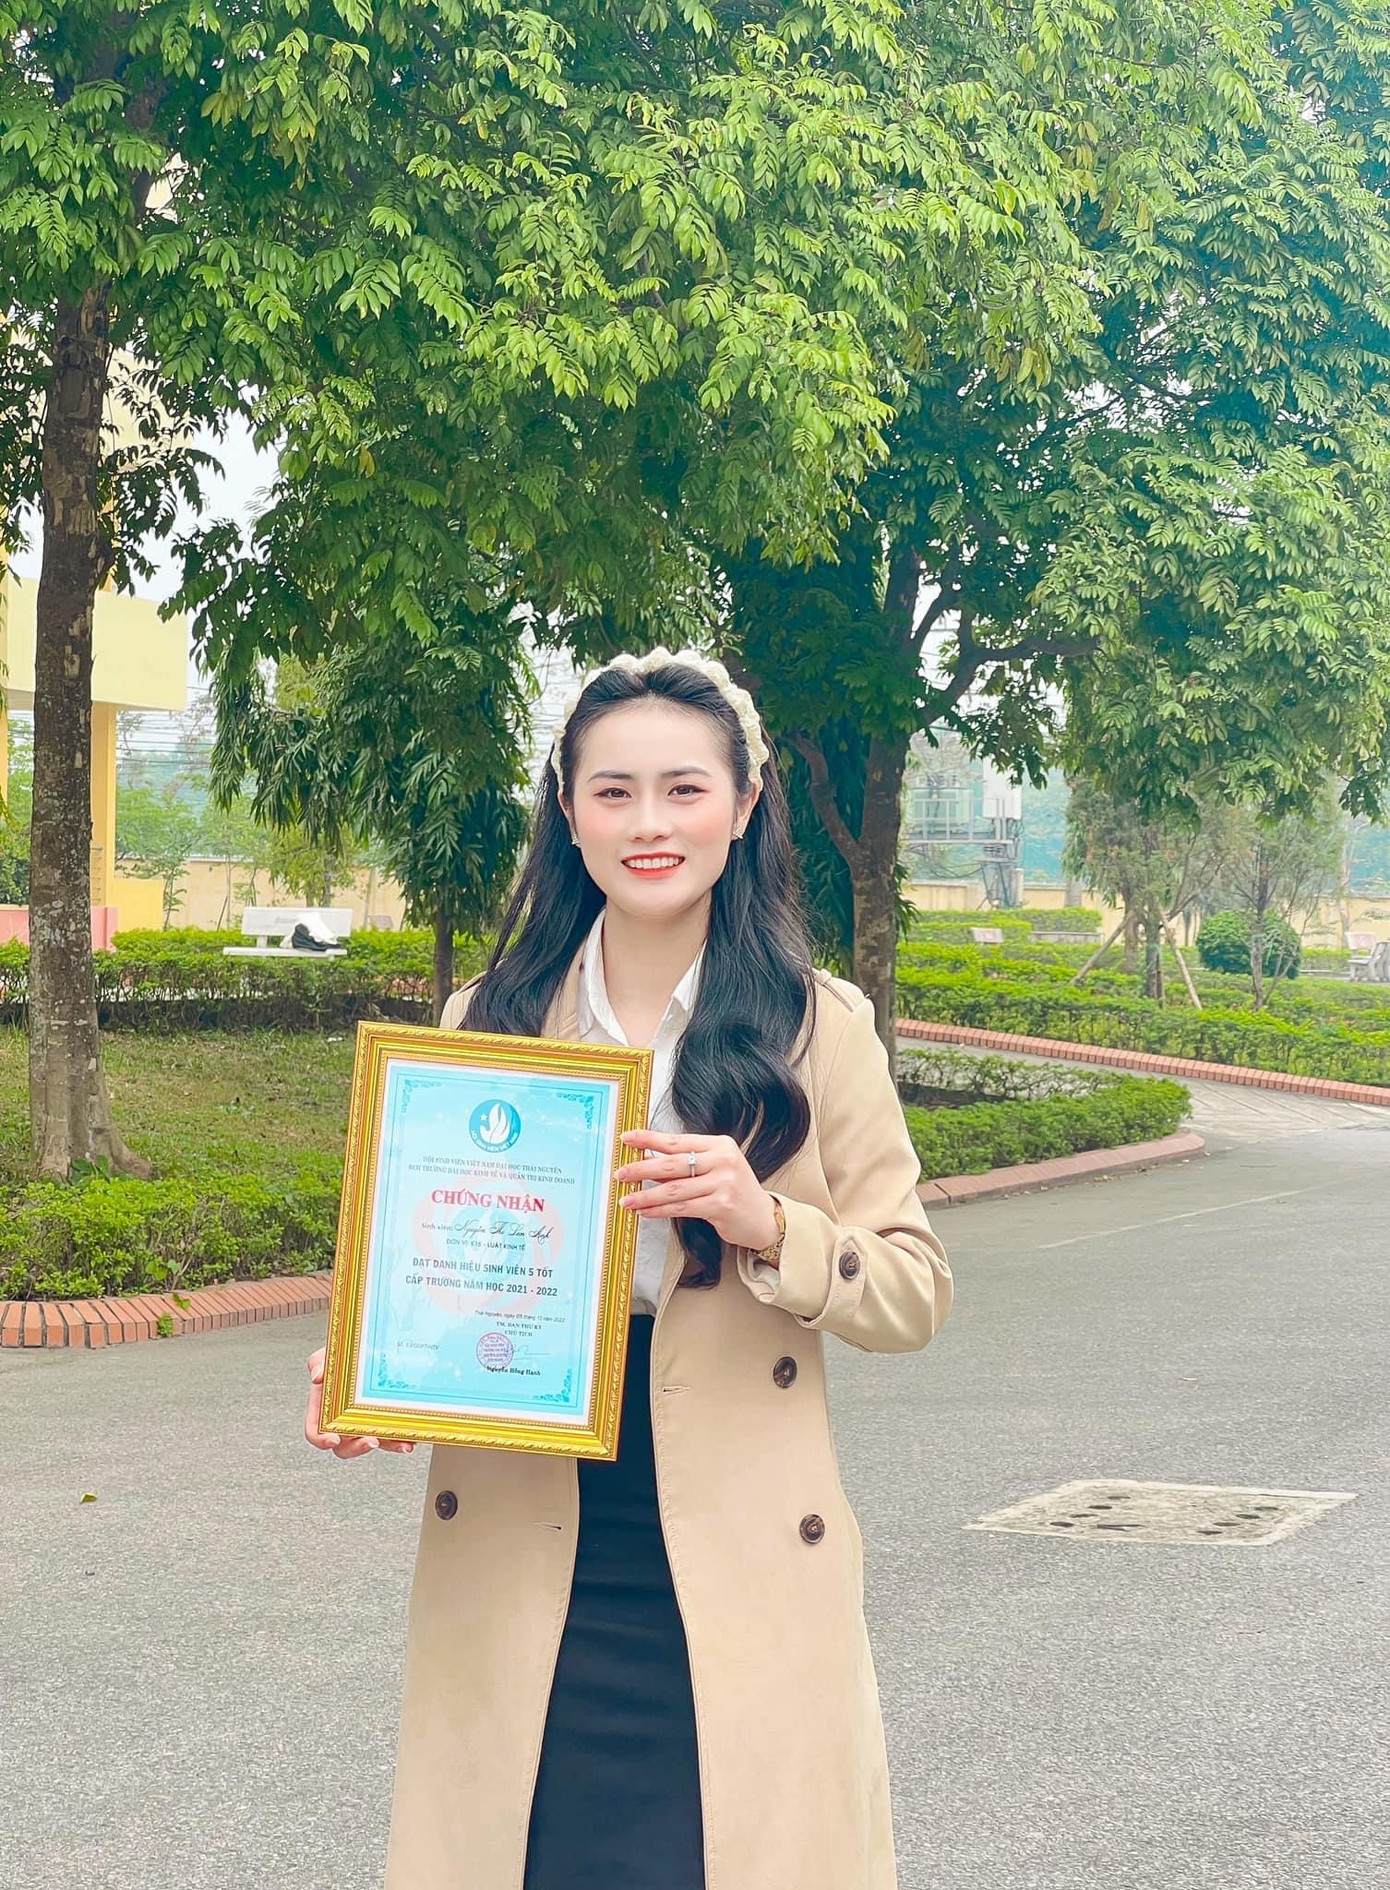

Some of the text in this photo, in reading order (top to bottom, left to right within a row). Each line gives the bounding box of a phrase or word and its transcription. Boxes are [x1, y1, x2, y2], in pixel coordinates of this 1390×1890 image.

[432, 1188, 545, 1214] CHỨNG NHẬN
[433, 1260, 458, 1270] DANH
[460, 1260, 481, 1273] HIỆU
[483, 1264, 504, 1274] SINH
[506, 1264, 526, 1276] VIÊN
[528, 1268, 534, 1276] 5
[537, 1265, 552, 1278] TỐT
[406, 1272, 422, 1285] CẤP
[464, 1278, 484, 1290] NĂM
[486, 1282, 504, 1294] HỌC
[506, 1284, 528, 1294] 2021
[536, 1286, 558, 1297] 2022
